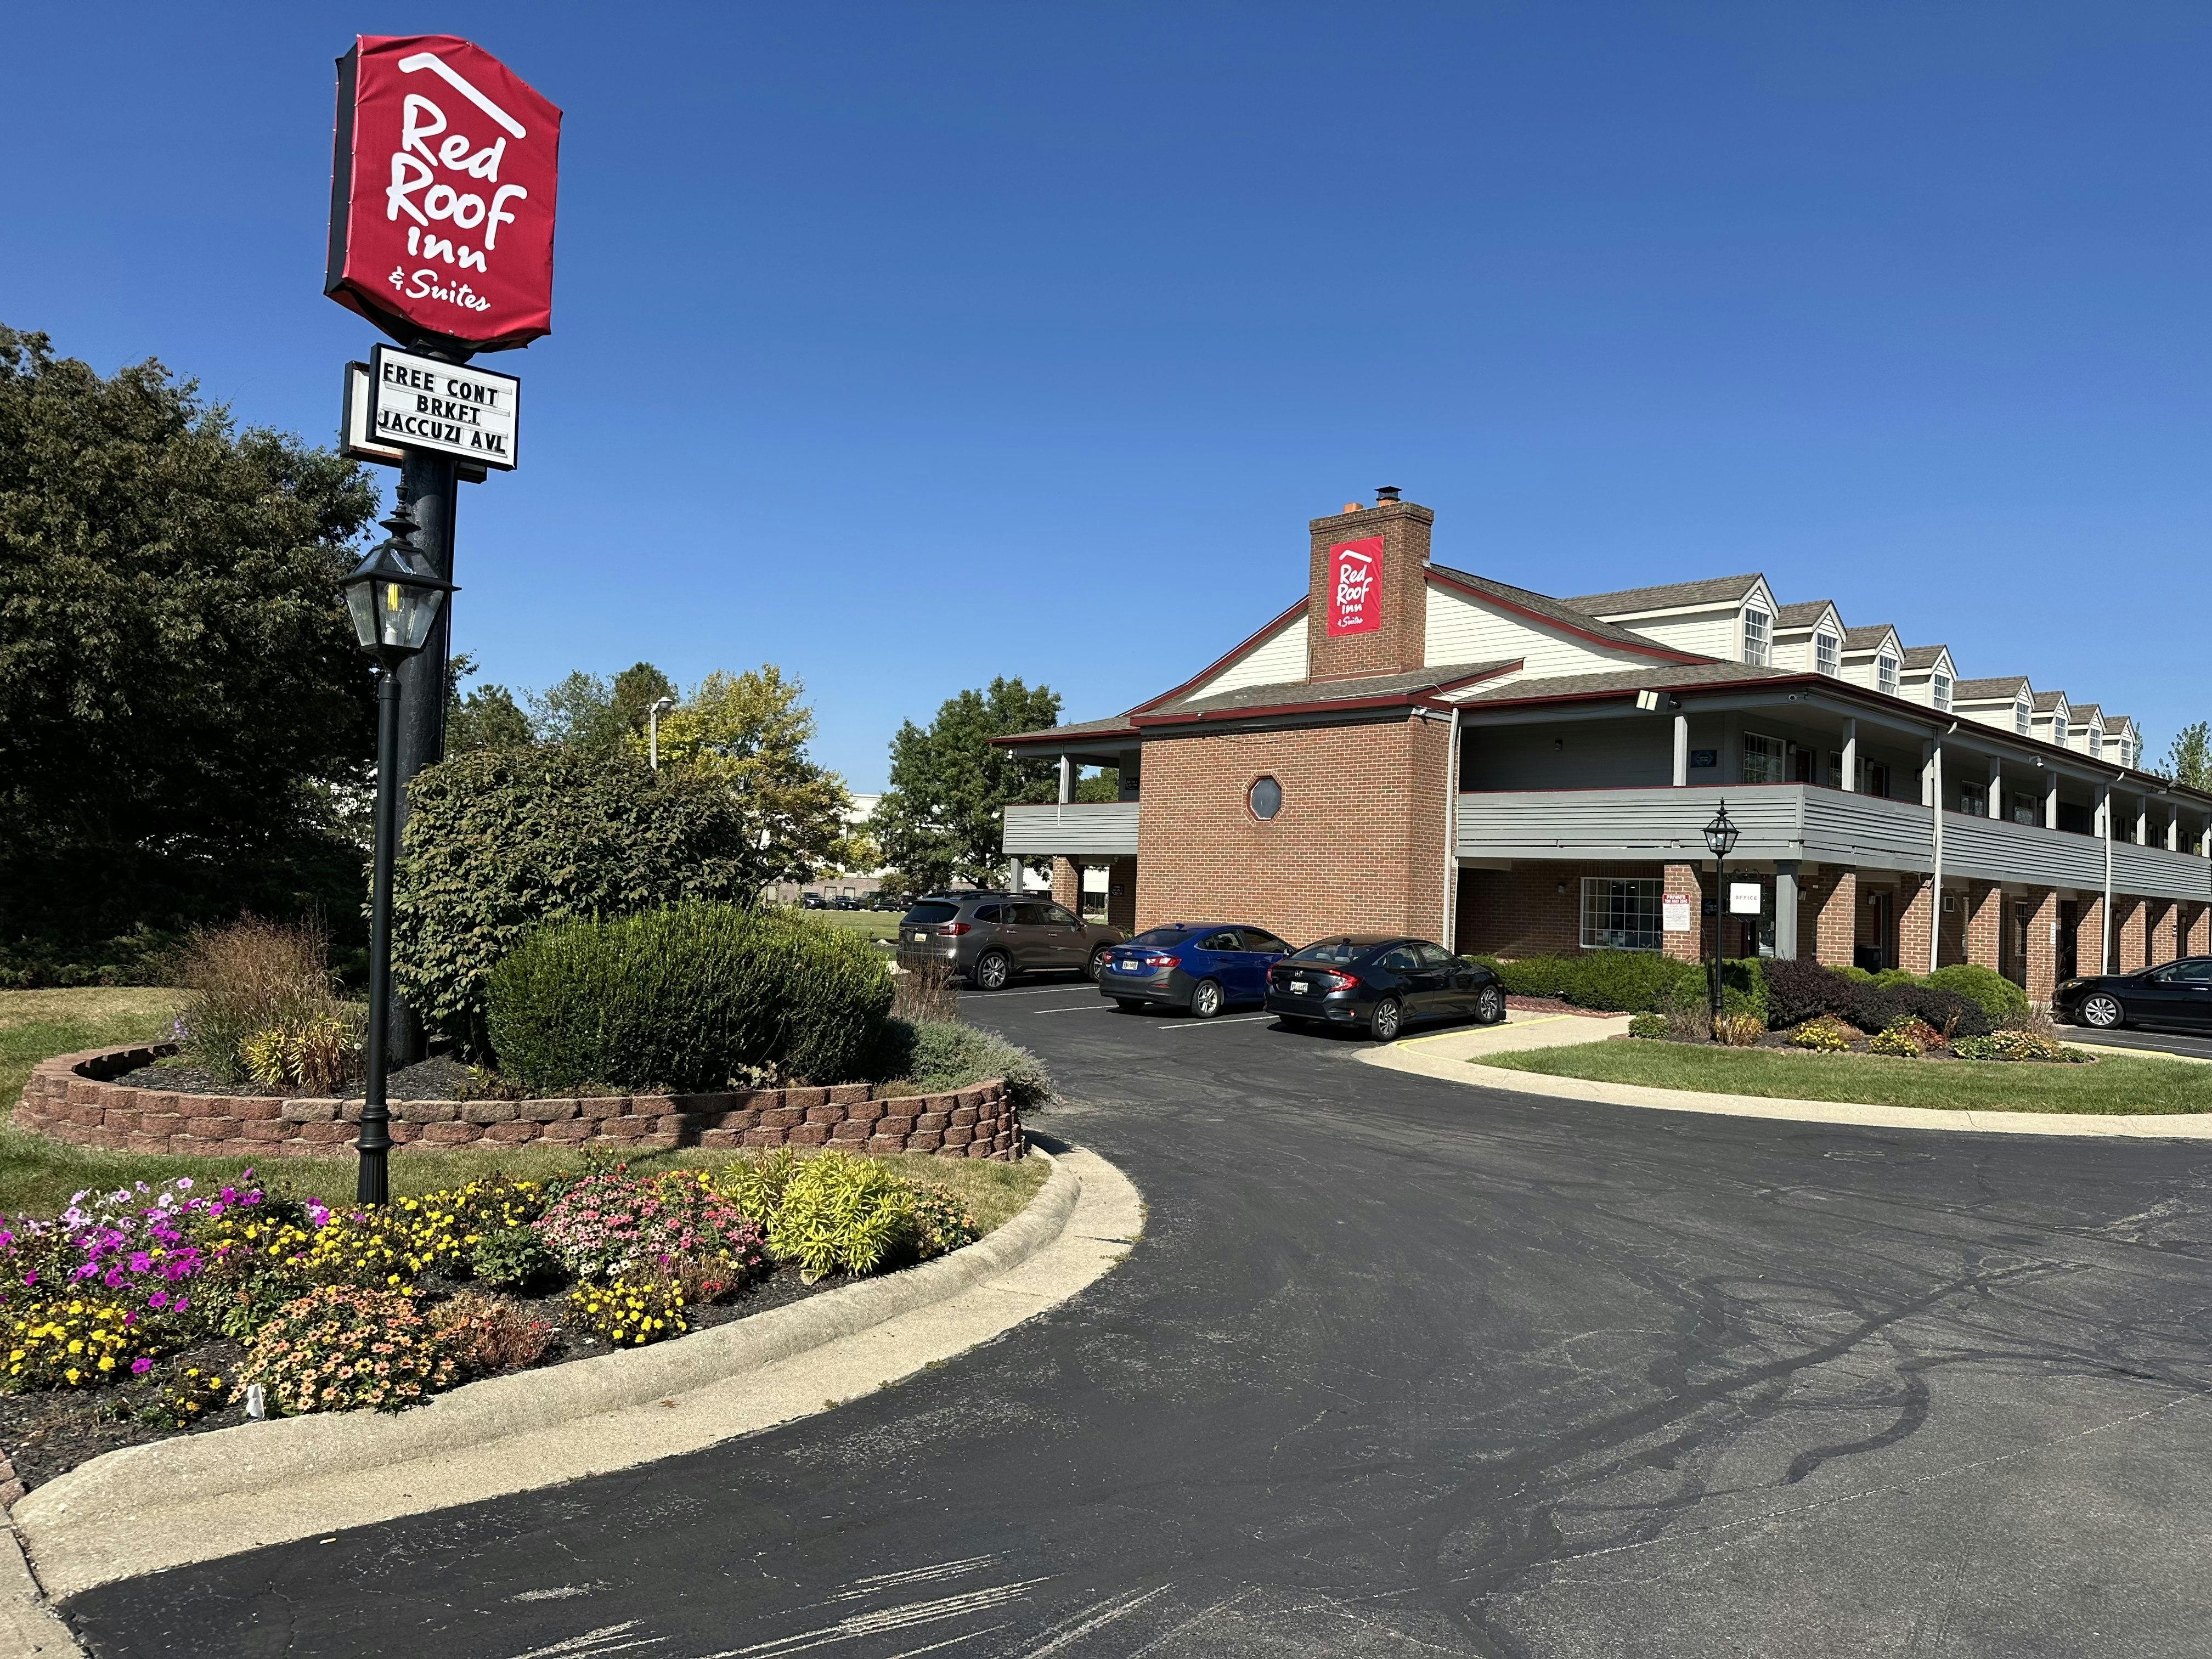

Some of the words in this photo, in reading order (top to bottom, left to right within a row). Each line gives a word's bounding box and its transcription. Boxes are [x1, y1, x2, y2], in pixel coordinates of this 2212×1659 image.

[402, 94, 506, 183] Red
[386, 152, 528, 250] Roof
[408, 226, 487, 273] Inn
[388, 266, 405, 291] &
[405, 269, 491, 312] Suites
[384, 362, 435, 391] FREE
[447, 379, 498, 405] CONT
[377, 410, 461, 443] JACCUZI
[471, 431, 506, 454] AVL
[1336, 577, 1373, 607] Roof
[1340, 563, 1368, 585] Red
[1341, 616, 1364, 628] Suites
